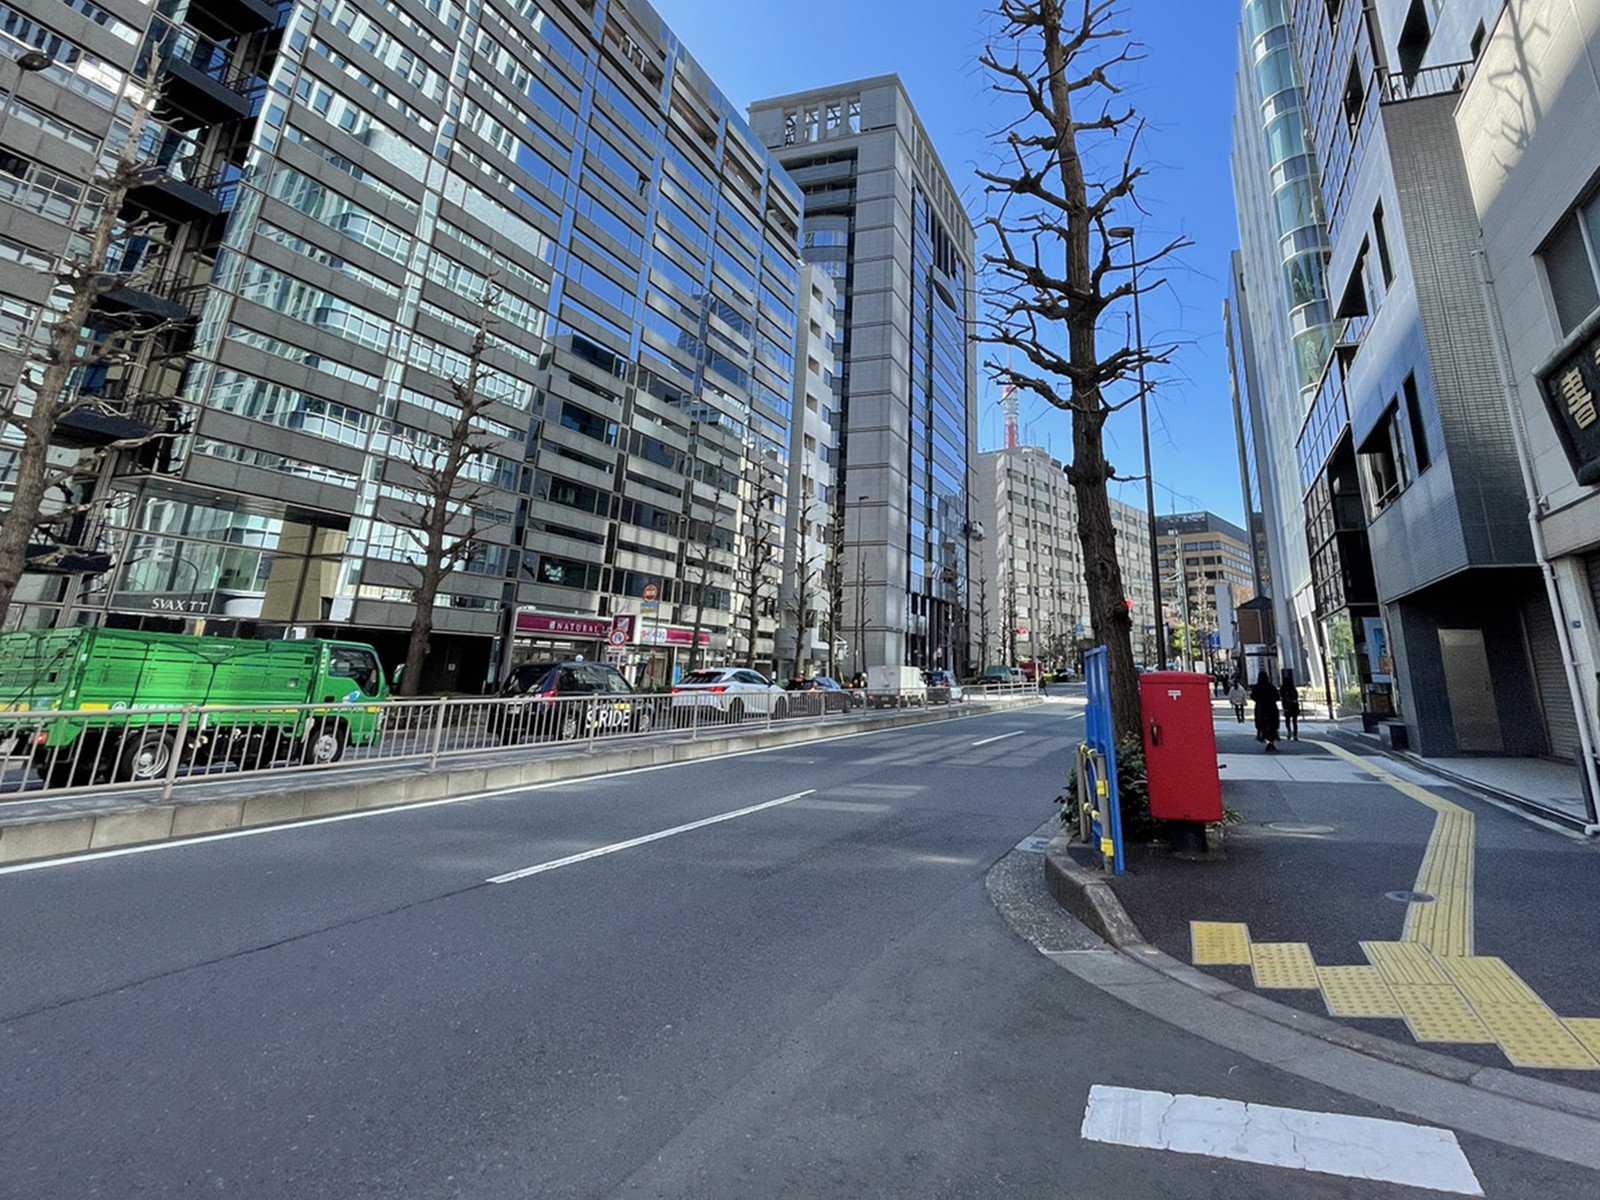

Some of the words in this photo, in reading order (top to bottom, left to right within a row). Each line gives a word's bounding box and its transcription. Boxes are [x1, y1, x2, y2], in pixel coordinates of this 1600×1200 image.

[1560, 347, 1600, 430] 書
[151, 597, 186, 611] SVAX
[189, 600, 209, 612] TT
[556, 622, 599, 633] NATURAL
